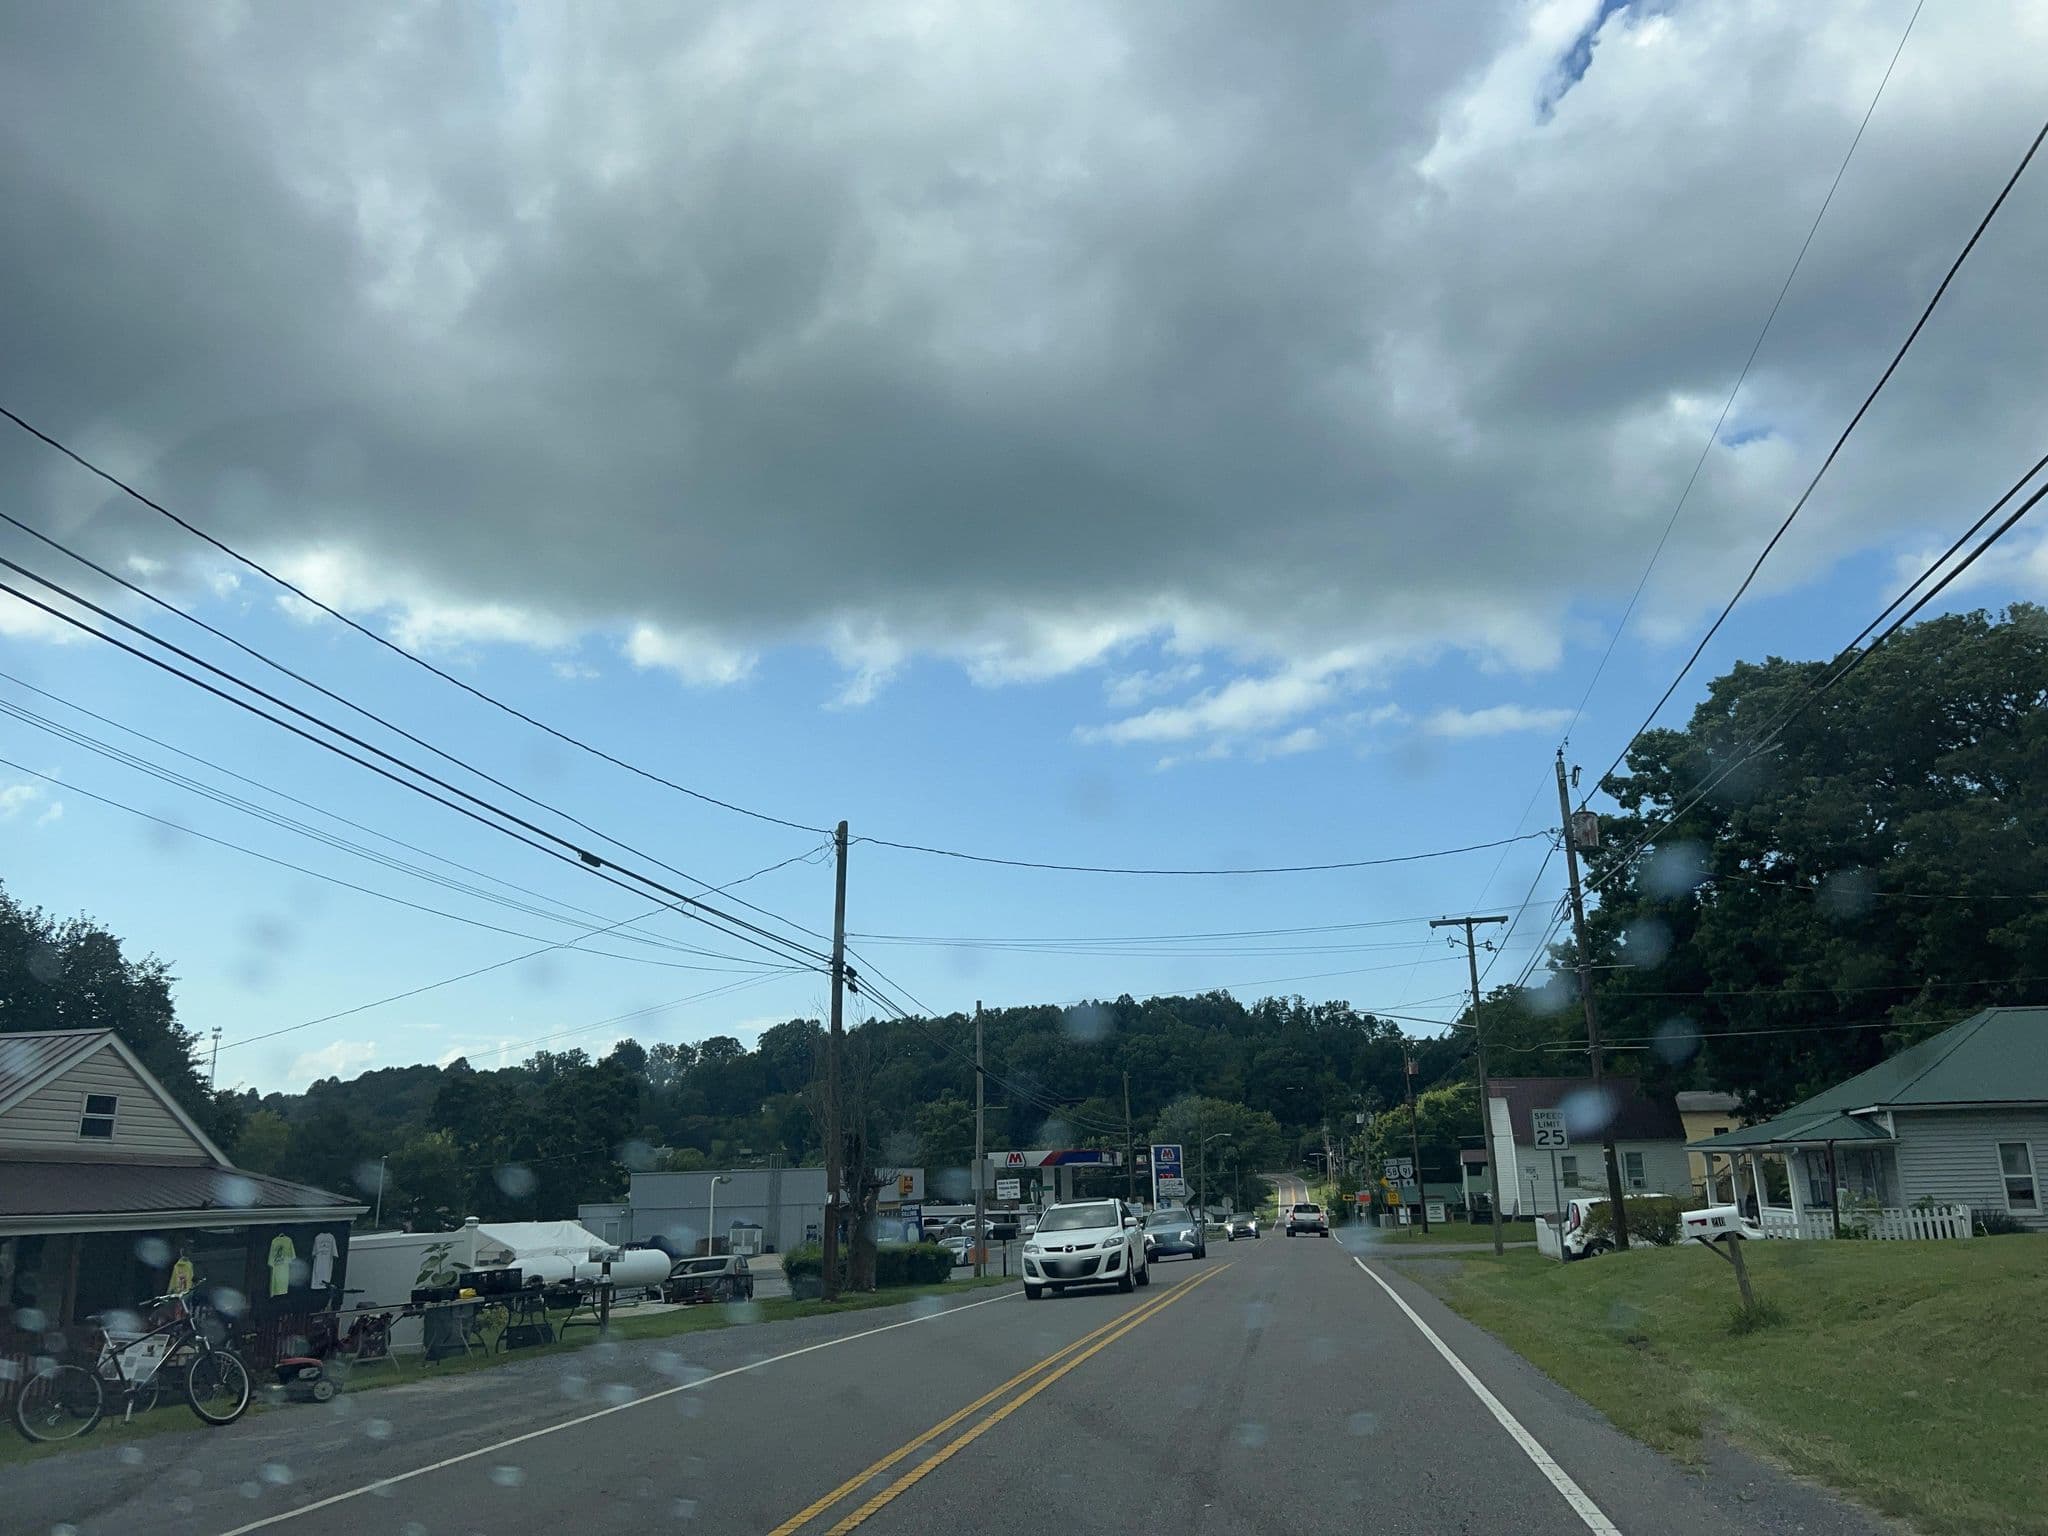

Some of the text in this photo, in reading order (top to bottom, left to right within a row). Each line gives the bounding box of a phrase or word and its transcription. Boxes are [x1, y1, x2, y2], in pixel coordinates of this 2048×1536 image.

[1534, 1112, 1564, 1120] SPEED
[1536, 1129, 1565, 1145] 25
[1009, 1153, 1022, 1163] M
[1387, 1167, 1411, 1176] 58 91
